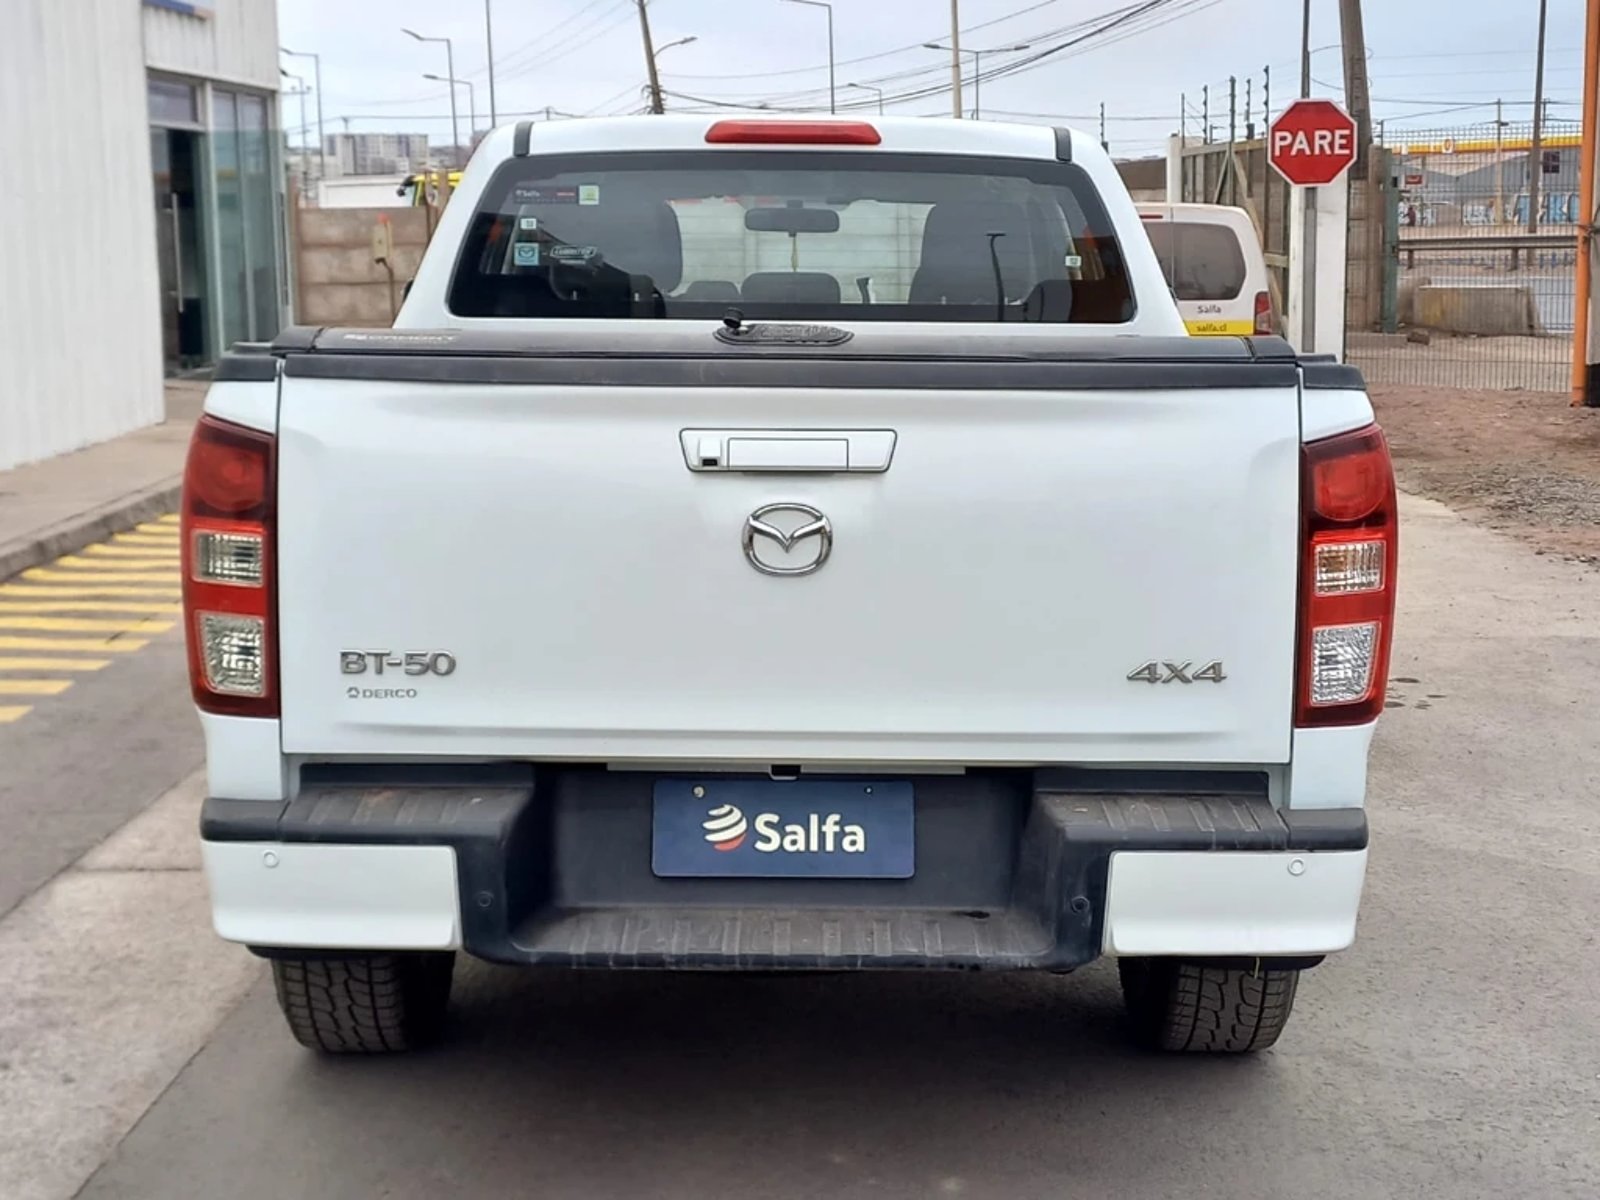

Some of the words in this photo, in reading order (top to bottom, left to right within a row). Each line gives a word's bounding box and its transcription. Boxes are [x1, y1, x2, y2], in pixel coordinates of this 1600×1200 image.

[1274, 129, 1351, 157] PARE
[340, 649, 457, 676] BT-50
[1126, 660, 1227, 684] 4X4
[362, 688, 418, 699] DERCO
[754, 812, 865, 852] Salfa
